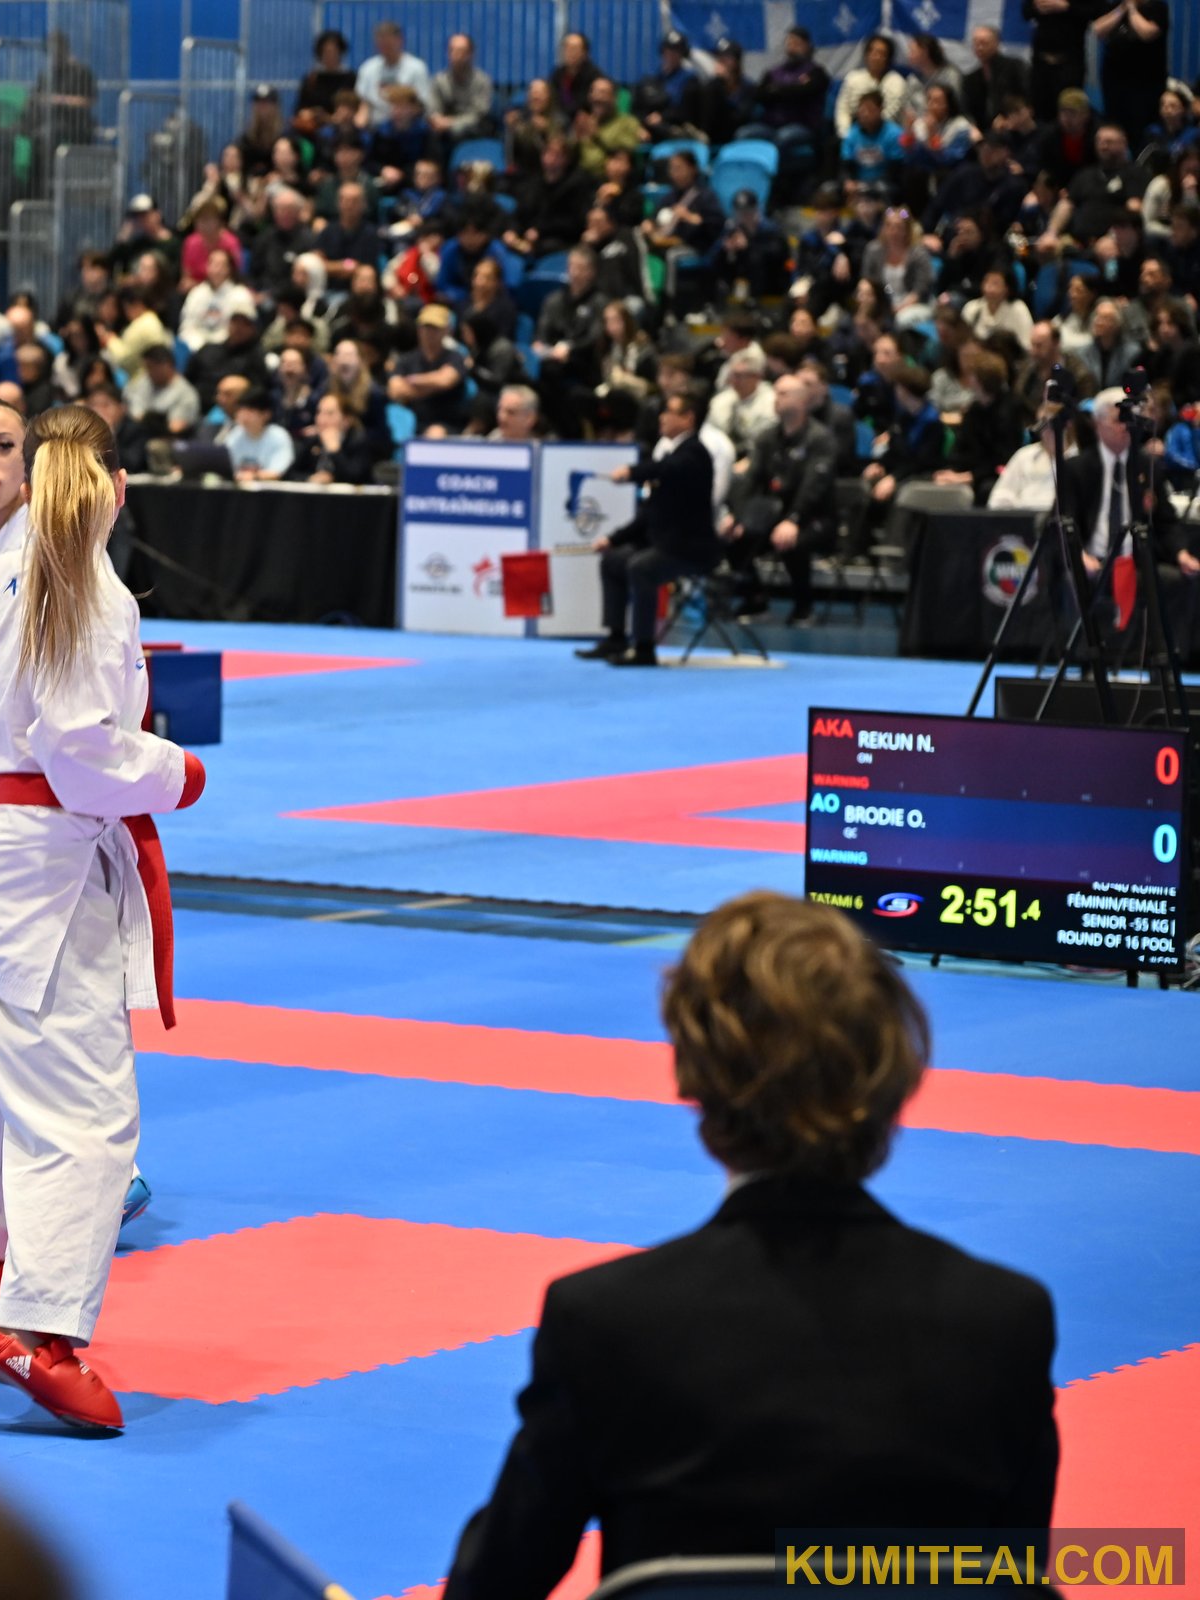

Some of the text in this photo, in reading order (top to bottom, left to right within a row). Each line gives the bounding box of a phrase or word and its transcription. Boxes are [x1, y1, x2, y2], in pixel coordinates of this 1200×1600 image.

[813, 718, 853, 738] AKA
[858, 730, 935, 752] REKUN N.
[1155, 746, 1180, 785] 0
[813, 773, 870, 790] WARNING
[810, 792, 840, 813] AO
[844, 805, 926, 828] BRODIE O.
[1153, 824, 1178, 863] 0
[810, 848, 868, 866] WARNING
[809, 891, 853, 909] TATAMI
[1067, 891, 1167, 914] FÉMININ/FEMALE
[1082, 913, 1126, 930] SENIOR
[1151, 918, 1169, 933] KG
[1057, 929, 1176, 953] ROUND OF 16 POOL
